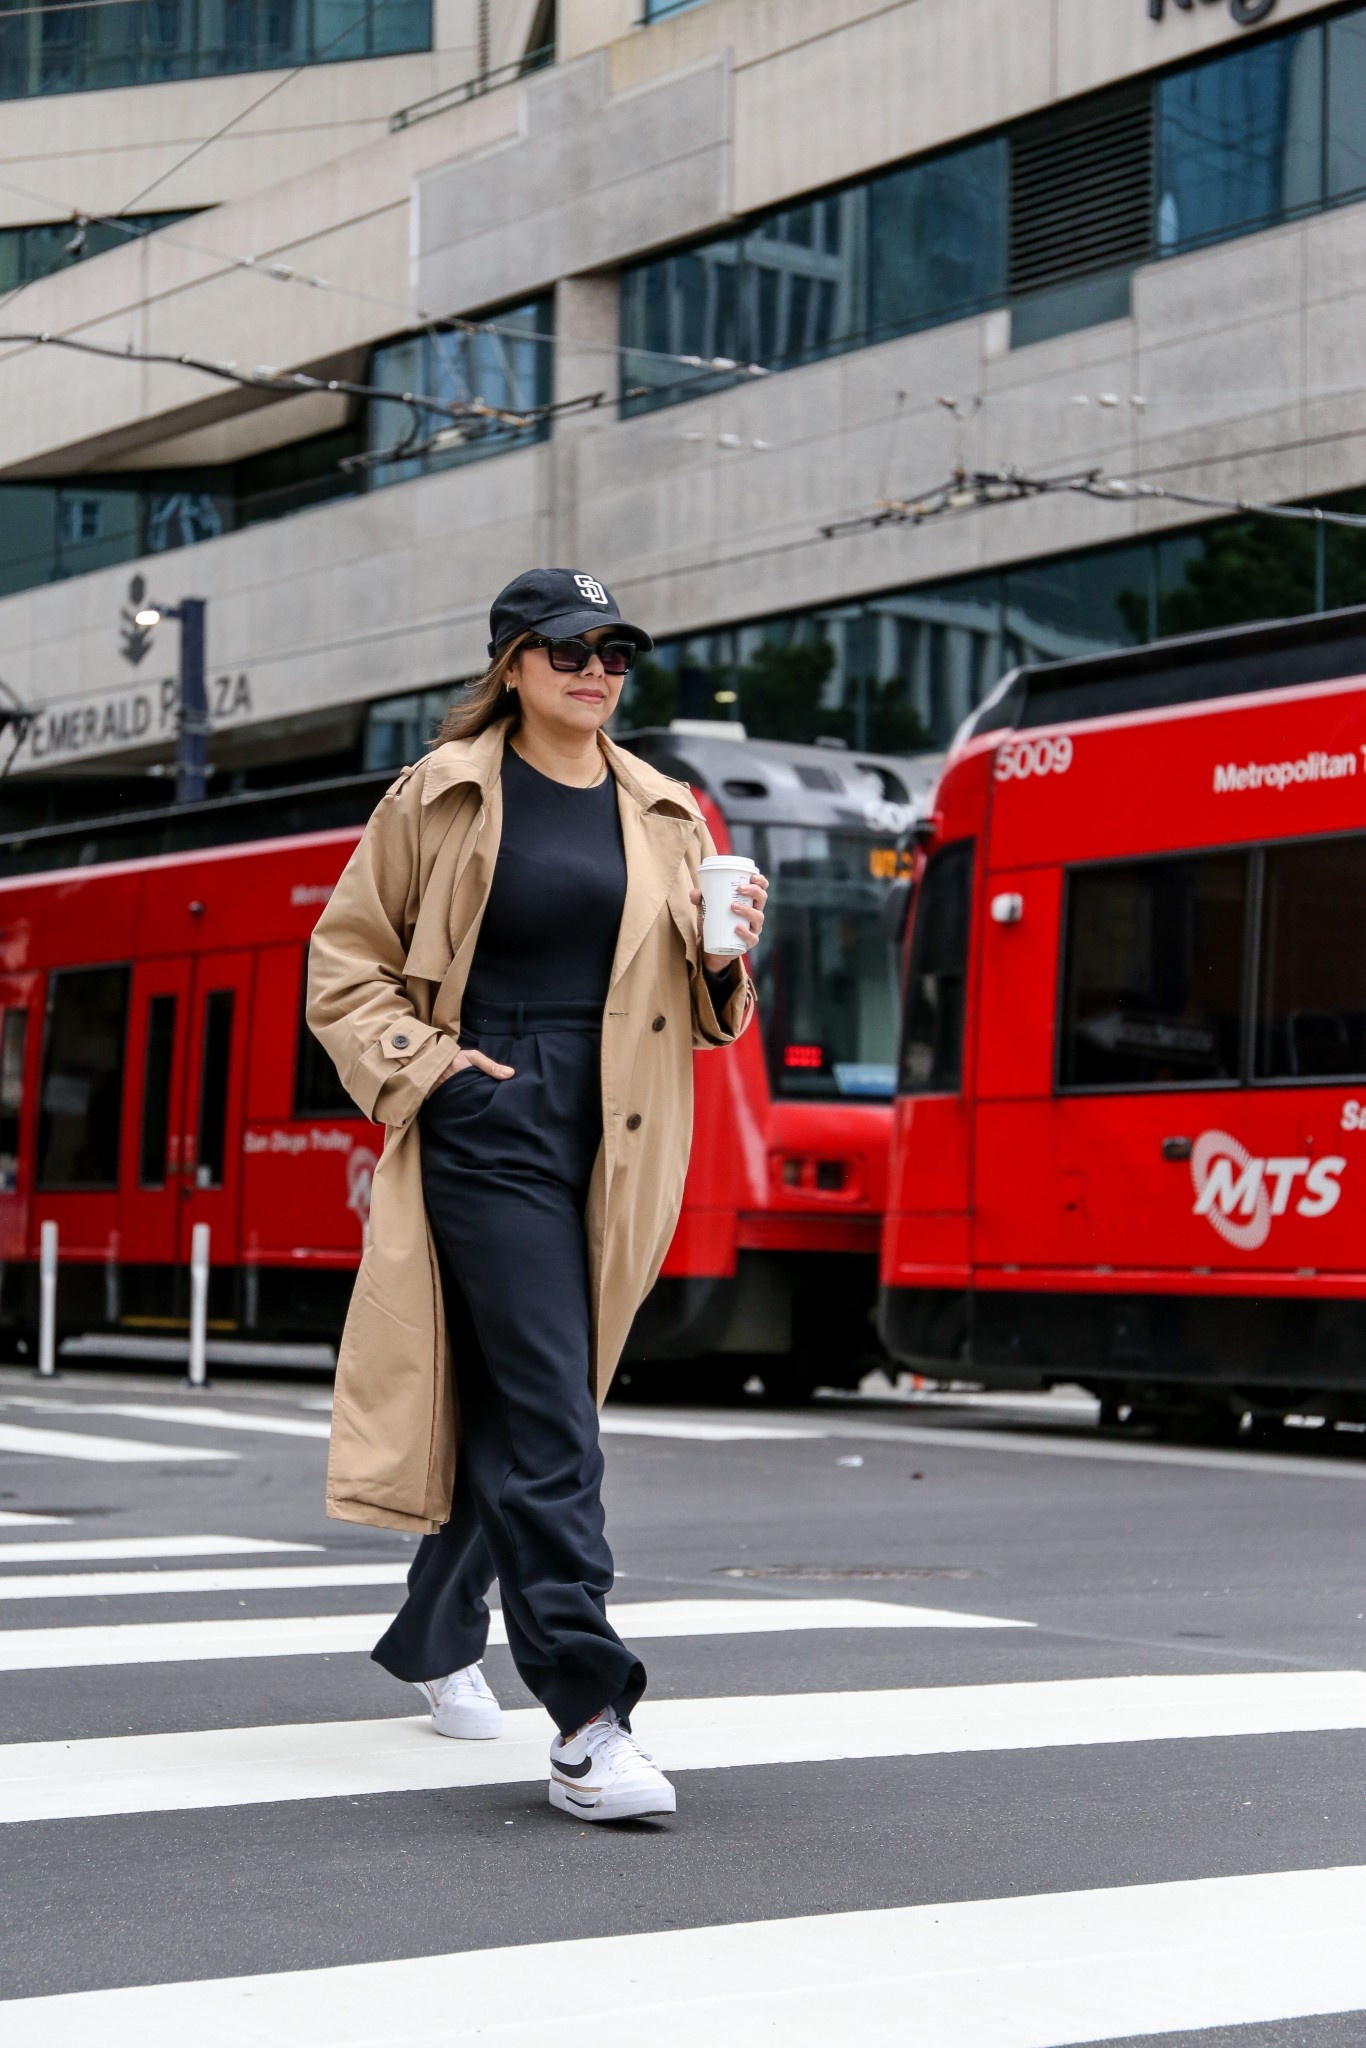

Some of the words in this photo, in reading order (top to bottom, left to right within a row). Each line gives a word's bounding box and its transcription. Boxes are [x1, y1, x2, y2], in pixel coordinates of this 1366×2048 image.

[573, 574, 609, 605] SD
[31, 696, 151, 758] EMERALD
[160, 674, 252, 730] PZA
[994, 735, 1073, 782] 5009
[1213, 751, 1357, 794] Metropolitan
[1192, 1155, 1347, 1217] MTS
